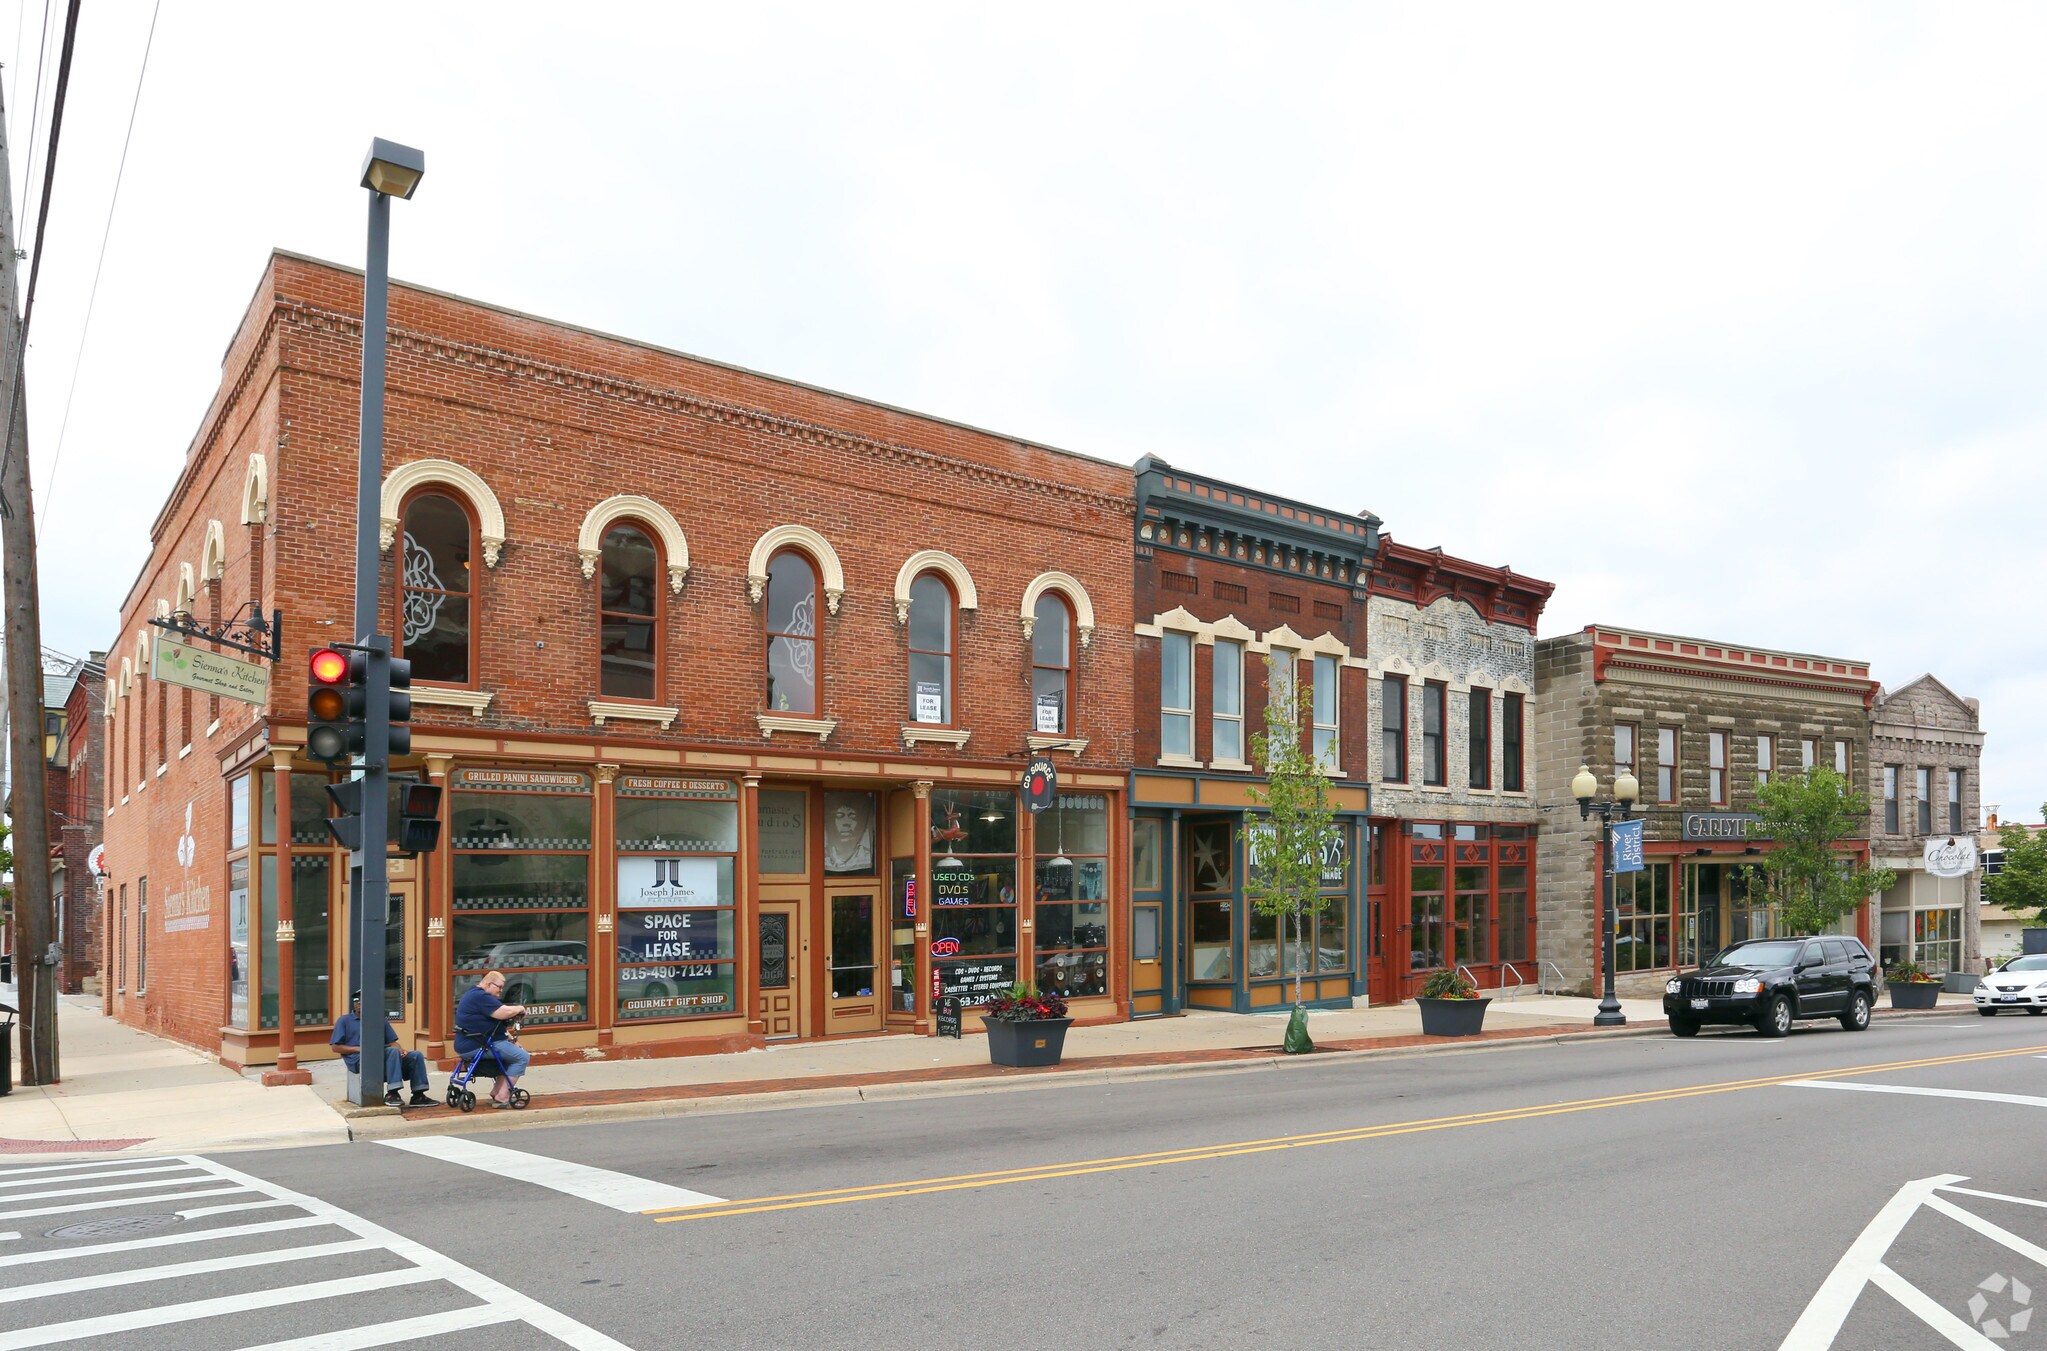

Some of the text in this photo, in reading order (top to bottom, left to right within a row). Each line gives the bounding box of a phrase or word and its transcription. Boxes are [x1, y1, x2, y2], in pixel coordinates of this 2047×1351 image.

[192, 654, 266, 686] Sienna's Kitchen
[191, 673, 213, 684] Gourmet
[214, 679, 228, 688] Shop
[239, 684, 255, 695] Eatery
[468, 772, 578, 784] GRILLED PANINI SANDWICHES
[1023, 762, 1054, 789] CD SOURCE
[628, 779, 652, 787] FRESH
[653, 780, 681, 788] COFFEE
[689, 781, 725, 790] DESSERTS
[758, 806, 790, 814] maste
[758, 815, 801, 828] udioS
[1622, 833, 1632, 861] River
[1632, 826, 1642, 865] District
[1927, 846, 1971, 862] Chocolat
[933, 873, 956, 881] USED
[640, 887, 695, 897] Joseph James
[907, 883, 915, 914] OPEN
[938, 897, 969, 906] GAMES
[644, 914, 691, 929] SPACE
[658, 930, 678, 941] FOR
[645, 942, 691, 958] LEASE
[930, 941, 959, 954] OPEN
[621, 964, 712, 980] 815-490-7124
[933, 969, 940, 980] WE
[968, 966, 980, 974] DVDS
[983, 965, 1003, 973] RECORDS
[960, 976, 975, 984] GAMES
[979, 974, 998, 982] SYSTEMS
[944, 981, 1013, 994] CASSETTES STEREO EQUIPMENT
[627, 995, 724, 1010] GOURMET GIFT SHOP
[944, 998, 952, 1007] WE
[525, 1004, 575, 1015] ARRY-OUT
[942, 1006, 953, 1016] BUY
